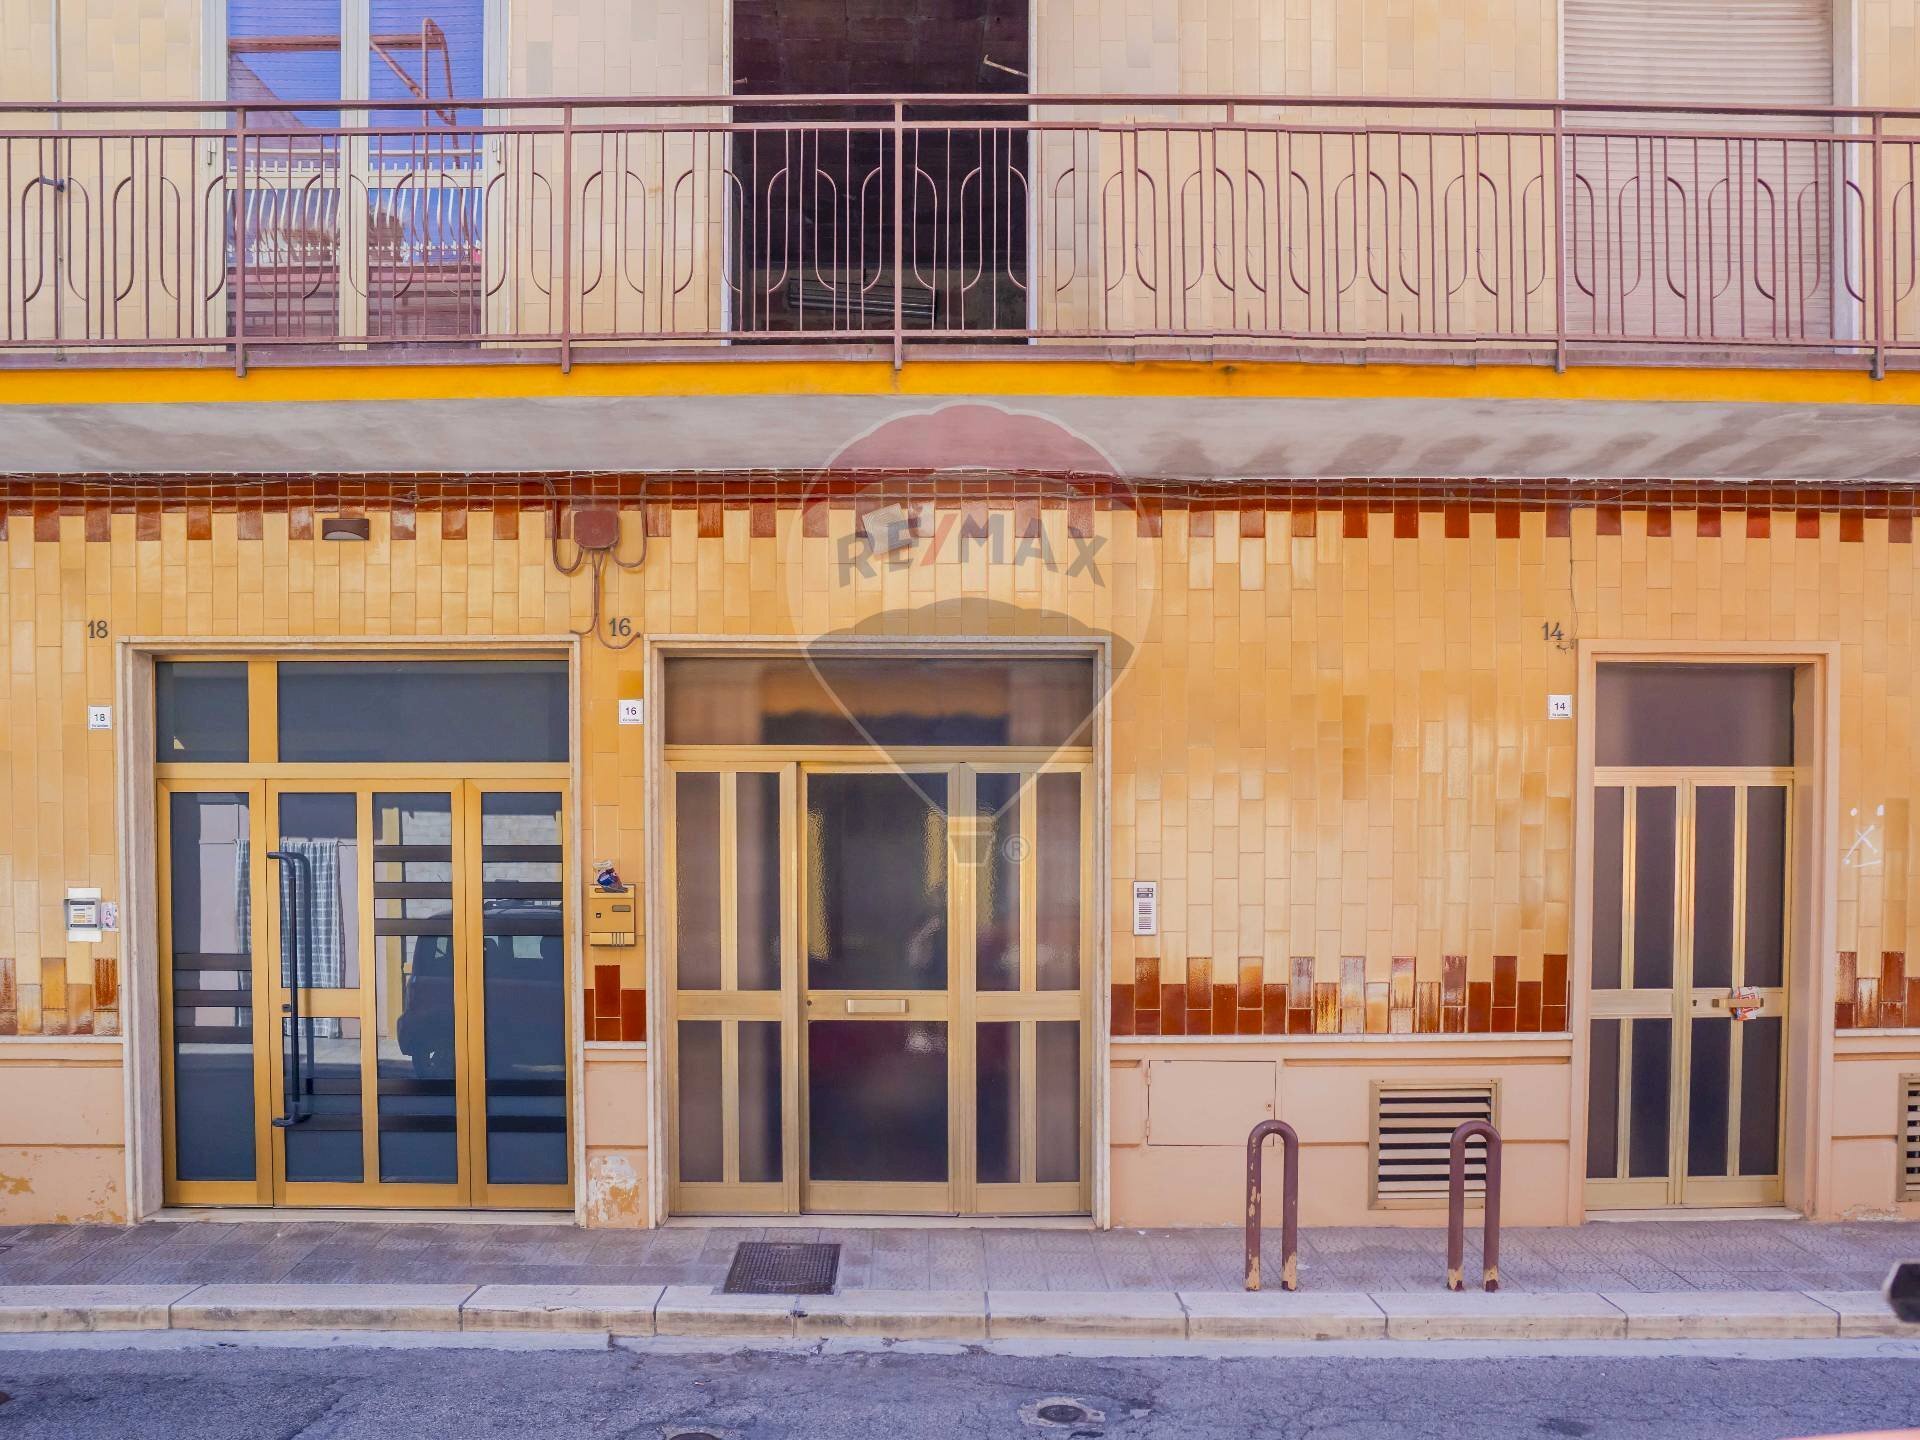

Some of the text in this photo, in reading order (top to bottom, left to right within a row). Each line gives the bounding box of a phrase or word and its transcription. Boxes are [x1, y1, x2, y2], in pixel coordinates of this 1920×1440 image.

[88, 620, 108, 638] 18
[609, 618, 631, 636] 16
[1542, 622, 1564, 640] 14
[625, 706, 637, 715] 16
[1554, 702, 1566, 710] 14
[94, 713, 106, 722] 18
